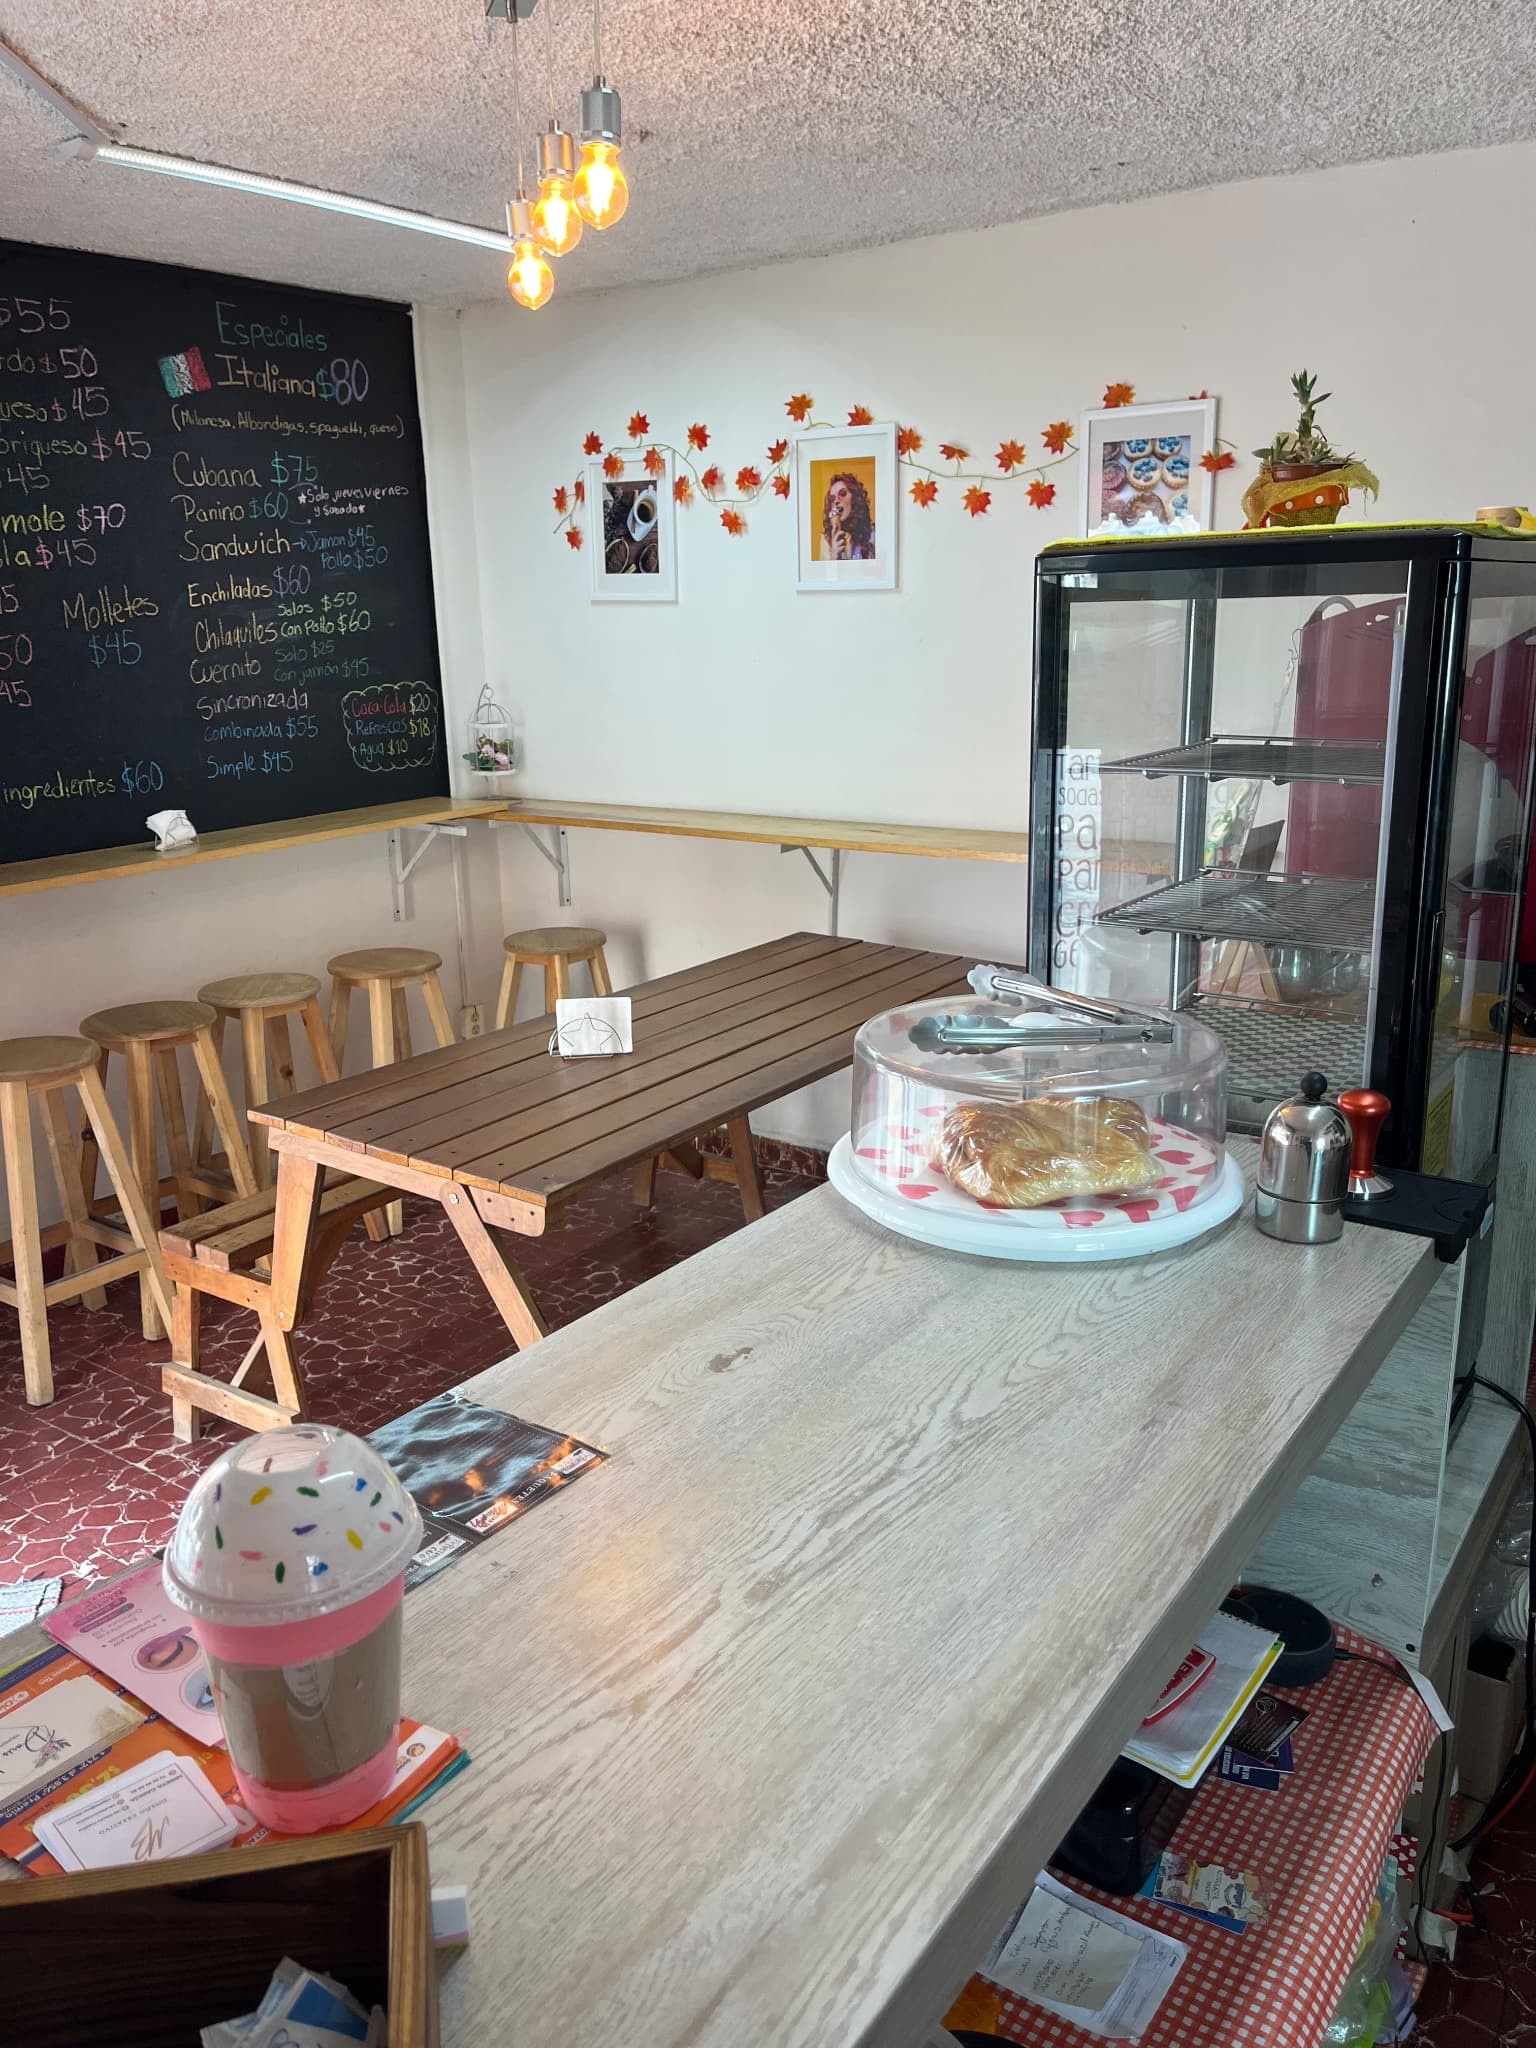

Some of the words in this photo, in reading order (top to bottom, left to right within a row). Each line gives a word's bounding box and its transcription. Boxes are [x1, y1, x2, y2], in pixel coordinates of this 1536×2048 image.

[215, 301, 328, 351] Especiales
[214, 353, 317, 398] Italiana
[315, 358, 370, 406] $80
[51, 386, 110, 421] $45
[91, 427, 151, 461] $45
[172, 451, 262, 488] Cubana
[270, 451, 318, 487] $75
[77, 503, 126, 535] $70
[170, 494, 245, 523] Panino
[249, 491, 288, 520] $60
[35, 536, 96, 569] $45
[179, 528, 291, 562] Sandwich
[320, 551, 352, 571] Pollo
[353, 544, 389, 571] $50
[187, 574, 273, 608] Enchiladas
[272, 564, 311, 599] $60
[62, 584, 160, 632] Molletes
[195, 612, 279, 653] Chilaquiles
[321, 591, 357, 612] $50
[337, 608, 371, 636] $60
[88, 629, 142, 669] $45
[190, 651, 262, 684] Cuernito
[196, 687, 308, 721] Sincronizada
[286, 714, 319, 739] $55
[207, 752, 255, 780] Simple
[261, 750, 294, 774] $45
[360, 742, 384, 763] Agua
[3, 769, 117, 810] ingredientes
[121, 761, 164, 799] $60
